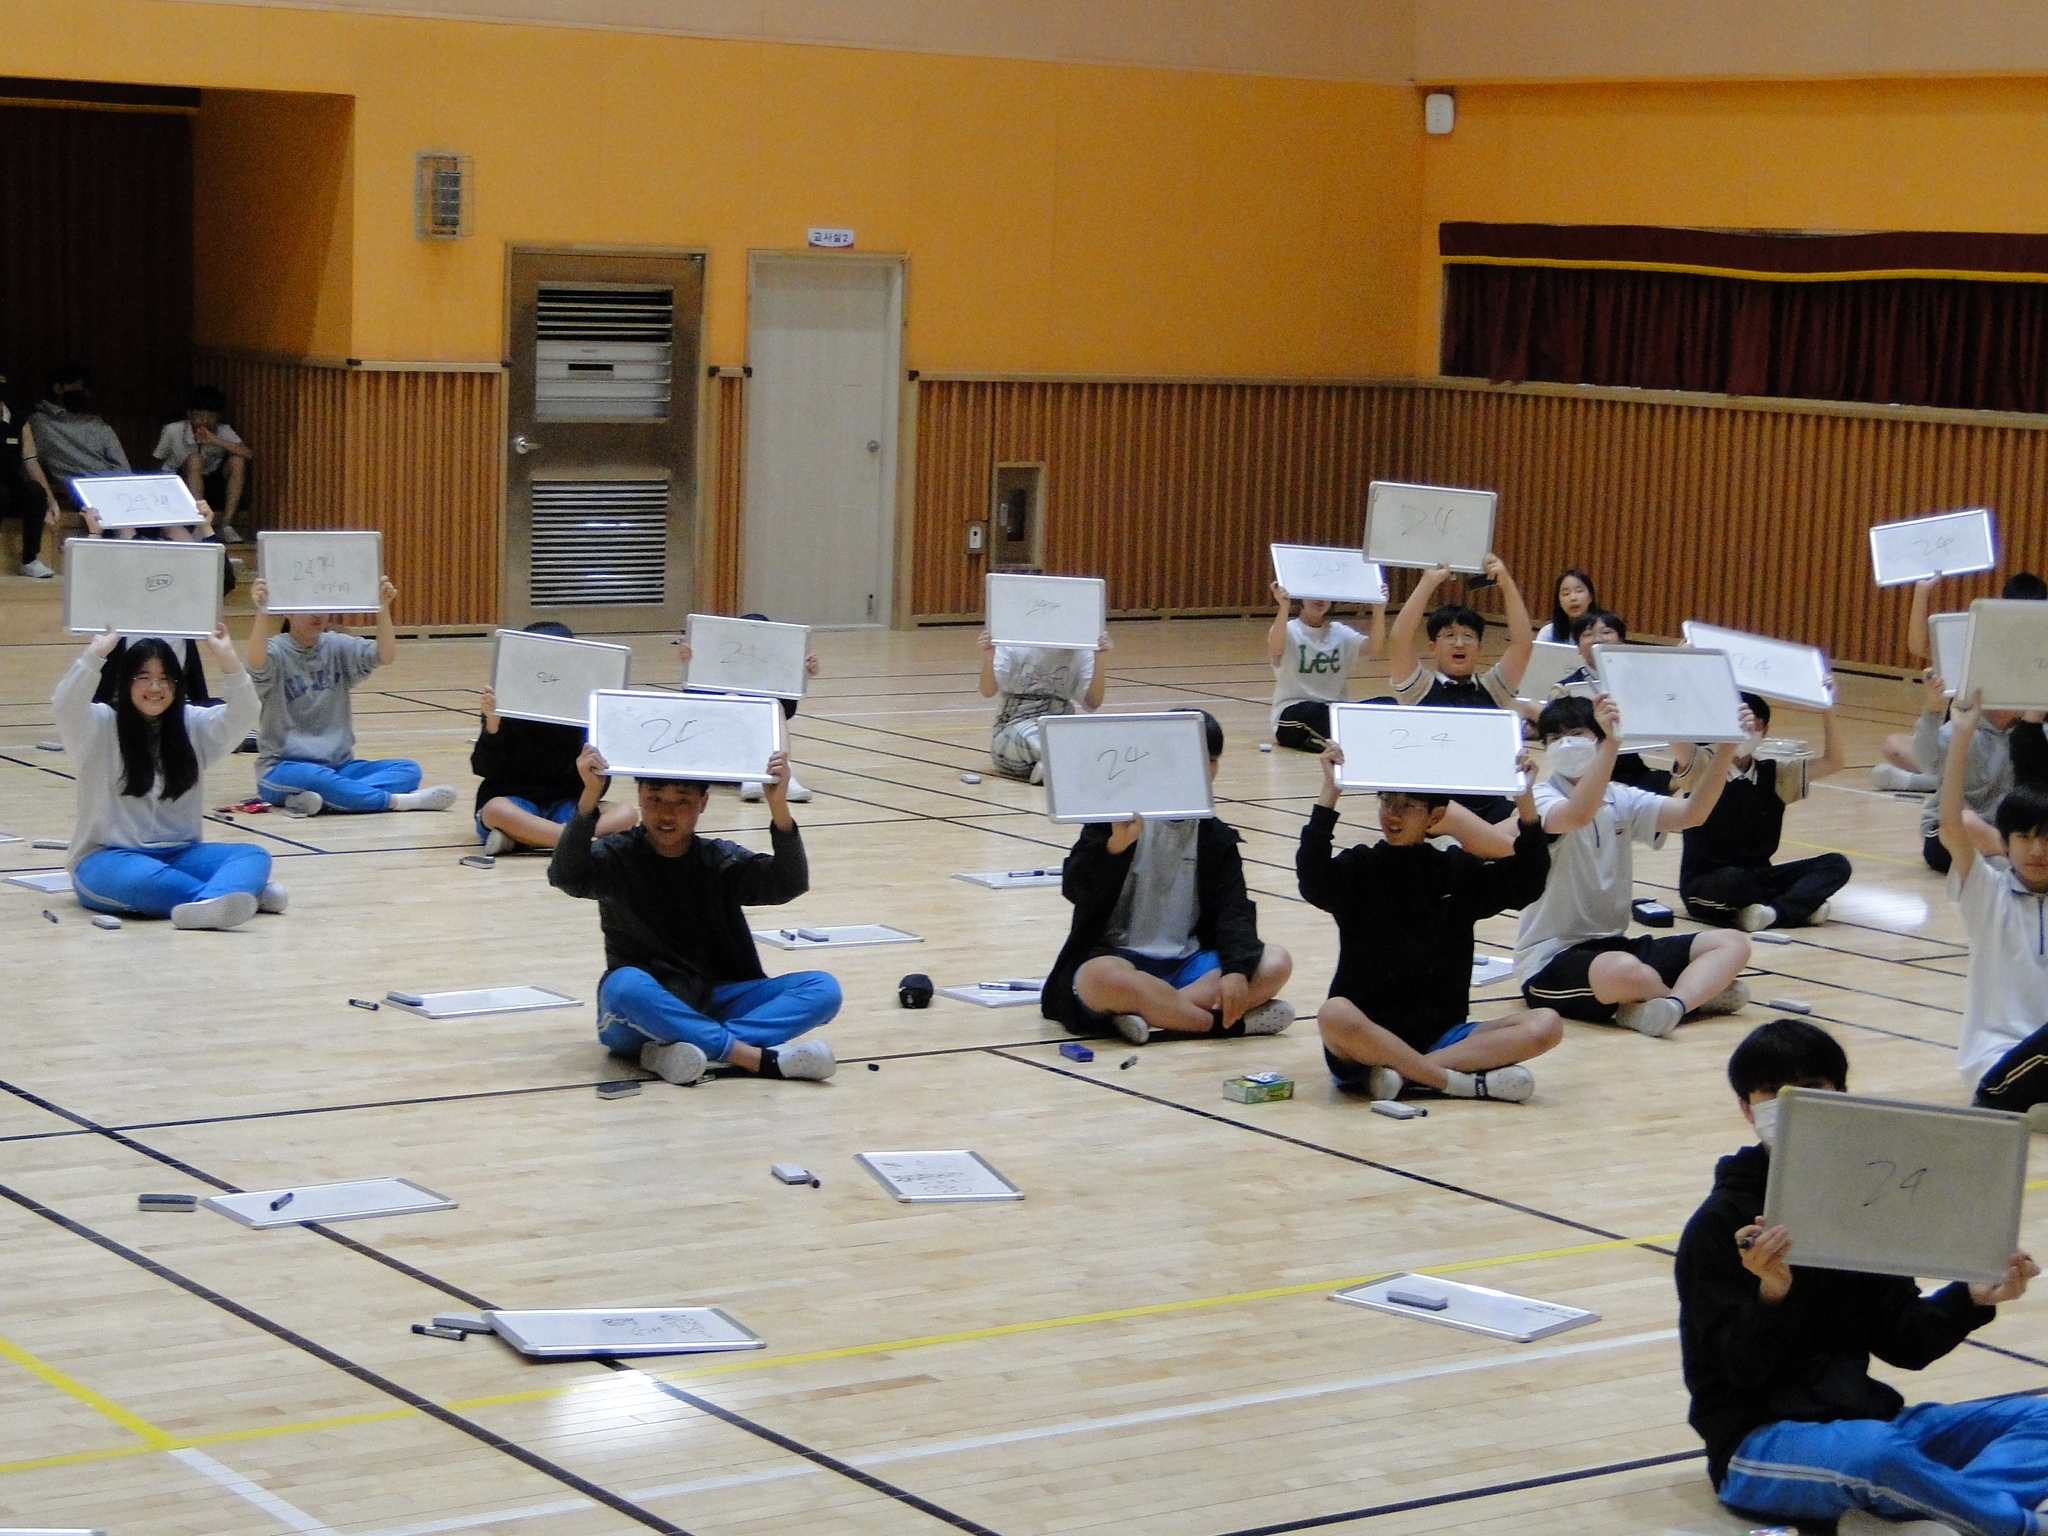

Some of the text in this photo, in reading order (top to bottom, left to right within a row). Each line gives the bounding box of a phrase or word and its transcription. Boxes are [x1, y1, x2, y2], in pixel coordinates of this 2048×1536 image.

[1298, 644, 1341, 674] Lee
[1389, 728, 1455, 750] 24
[1096, 745, 1151, 781] 24
